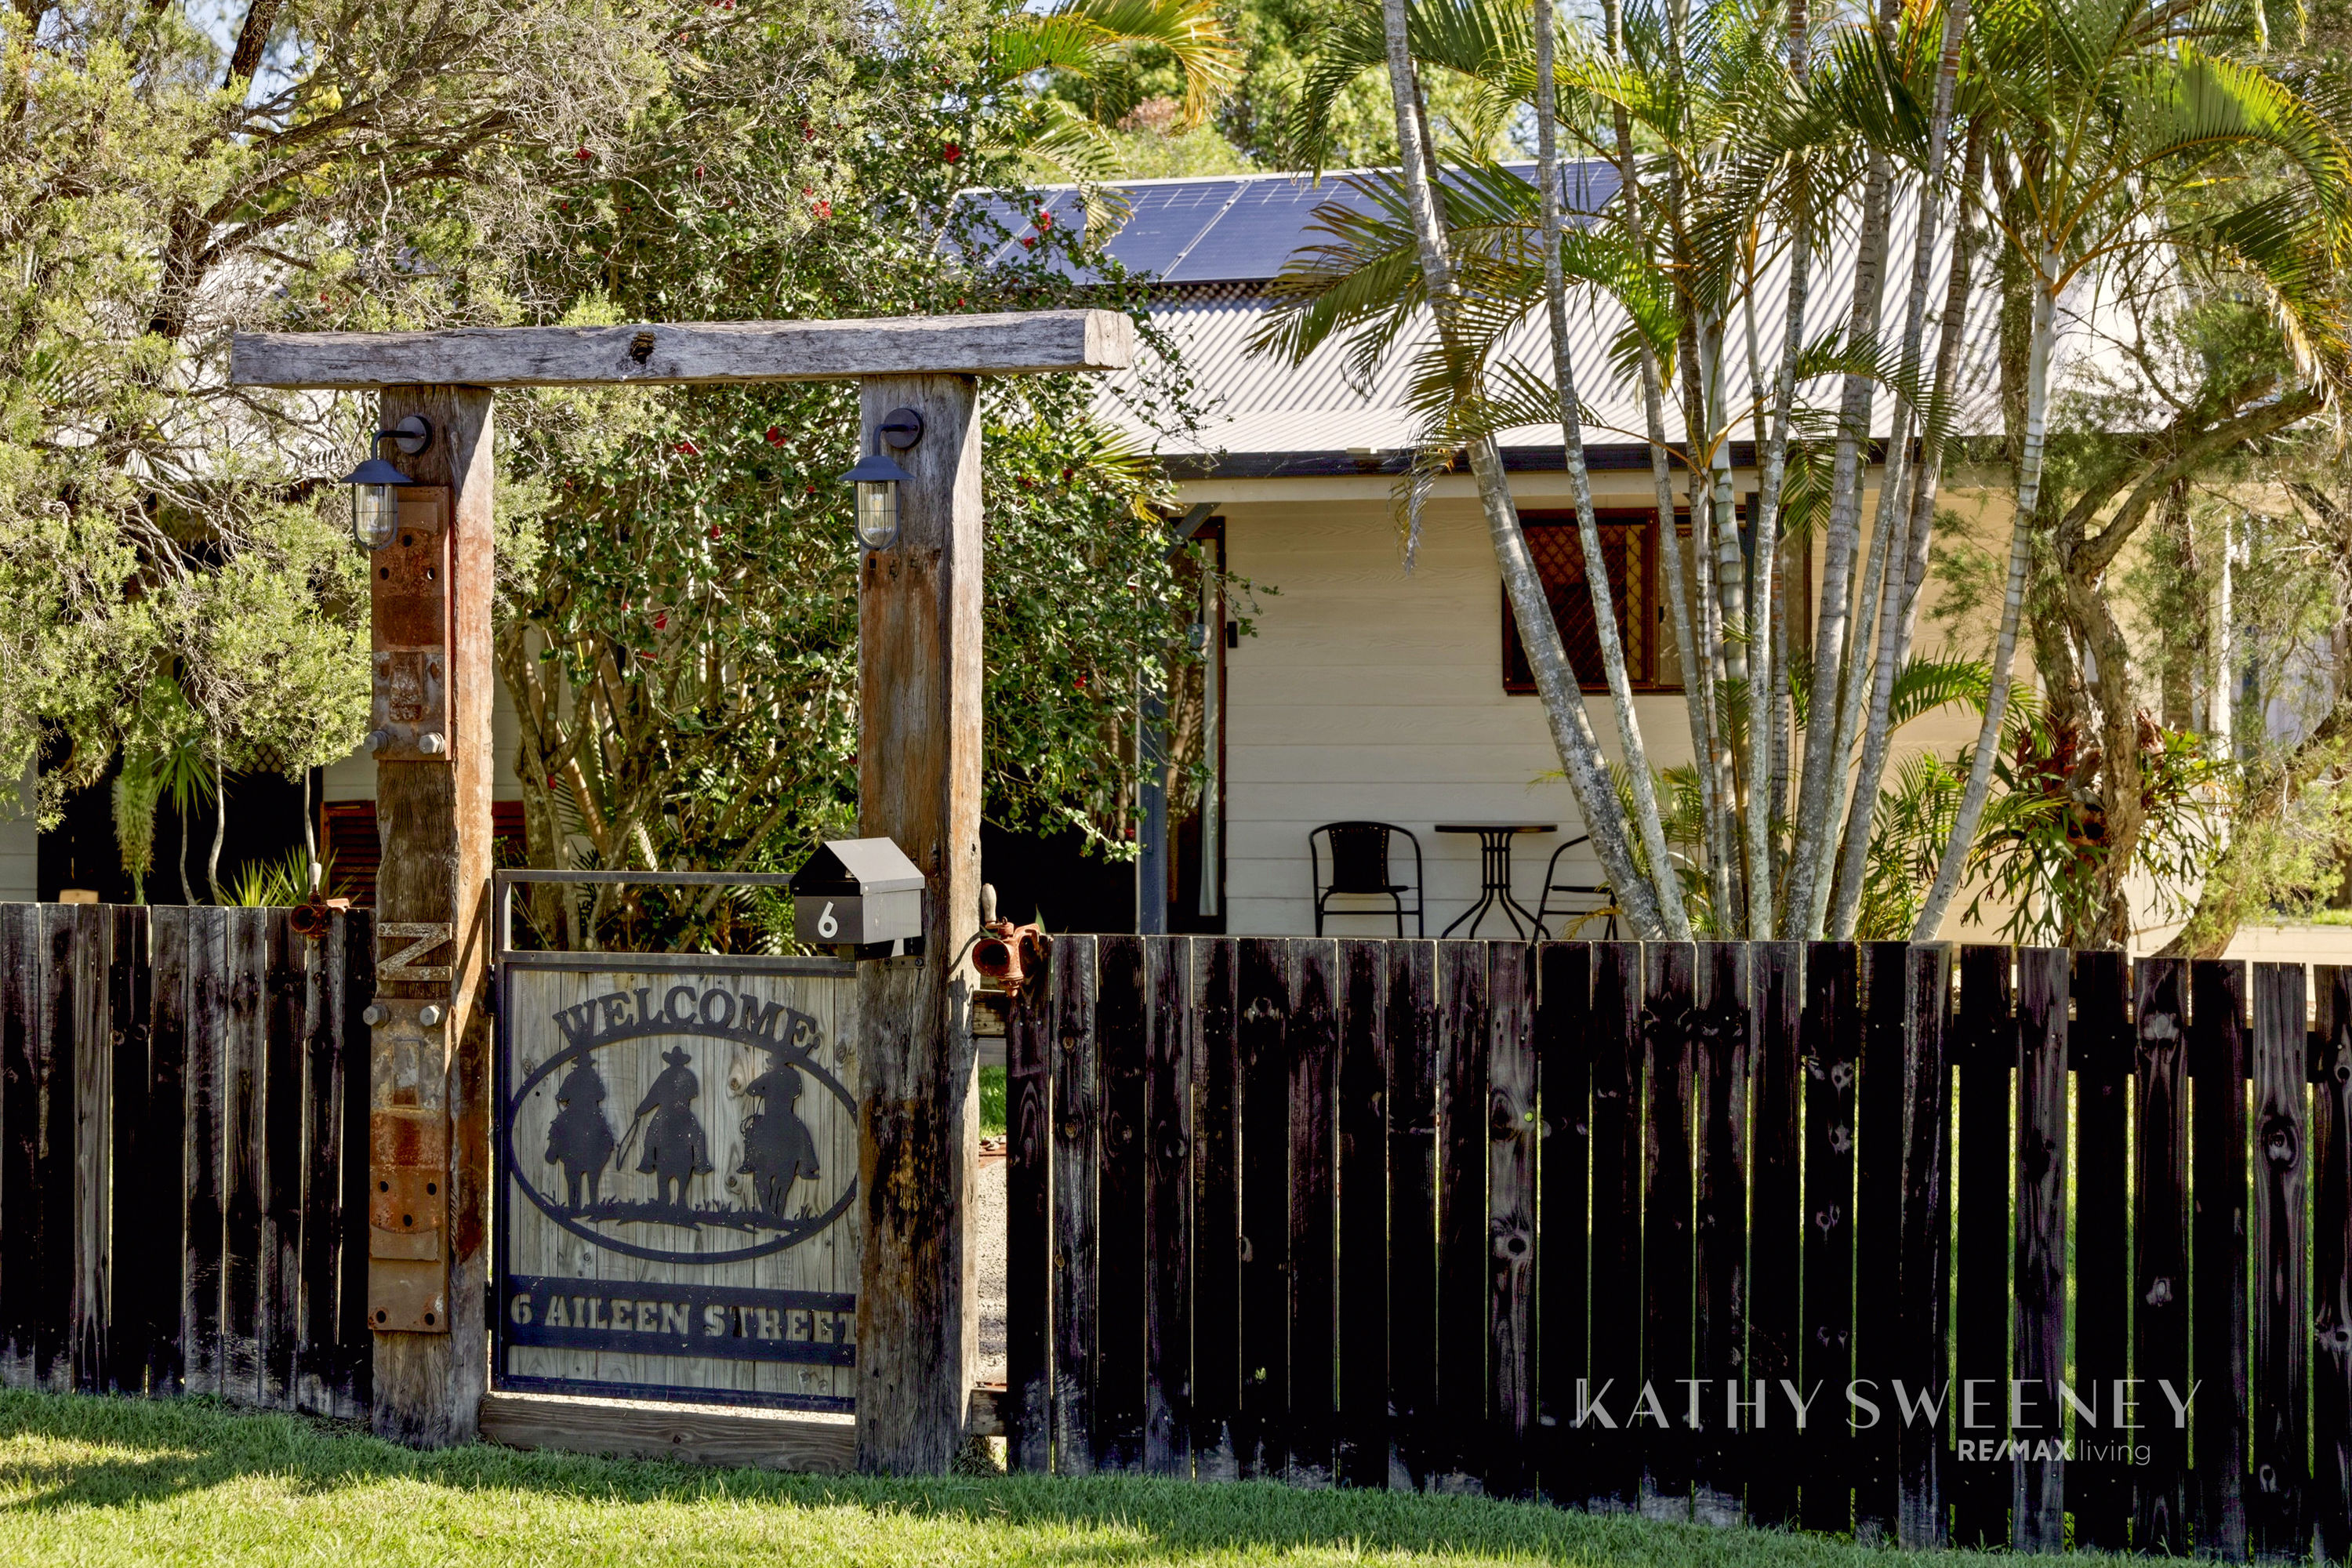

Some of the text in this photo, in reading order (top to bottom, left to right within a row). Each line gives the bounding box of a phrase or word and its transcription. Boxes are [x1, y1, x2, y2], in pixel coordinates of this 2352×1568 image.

[818, 901, 838, 938] 6
[552, 985, 821, 1051] WELCOME
[510, 1294, 533, 1325] 6
[544, 1295, 691, 1334] AILEEN
